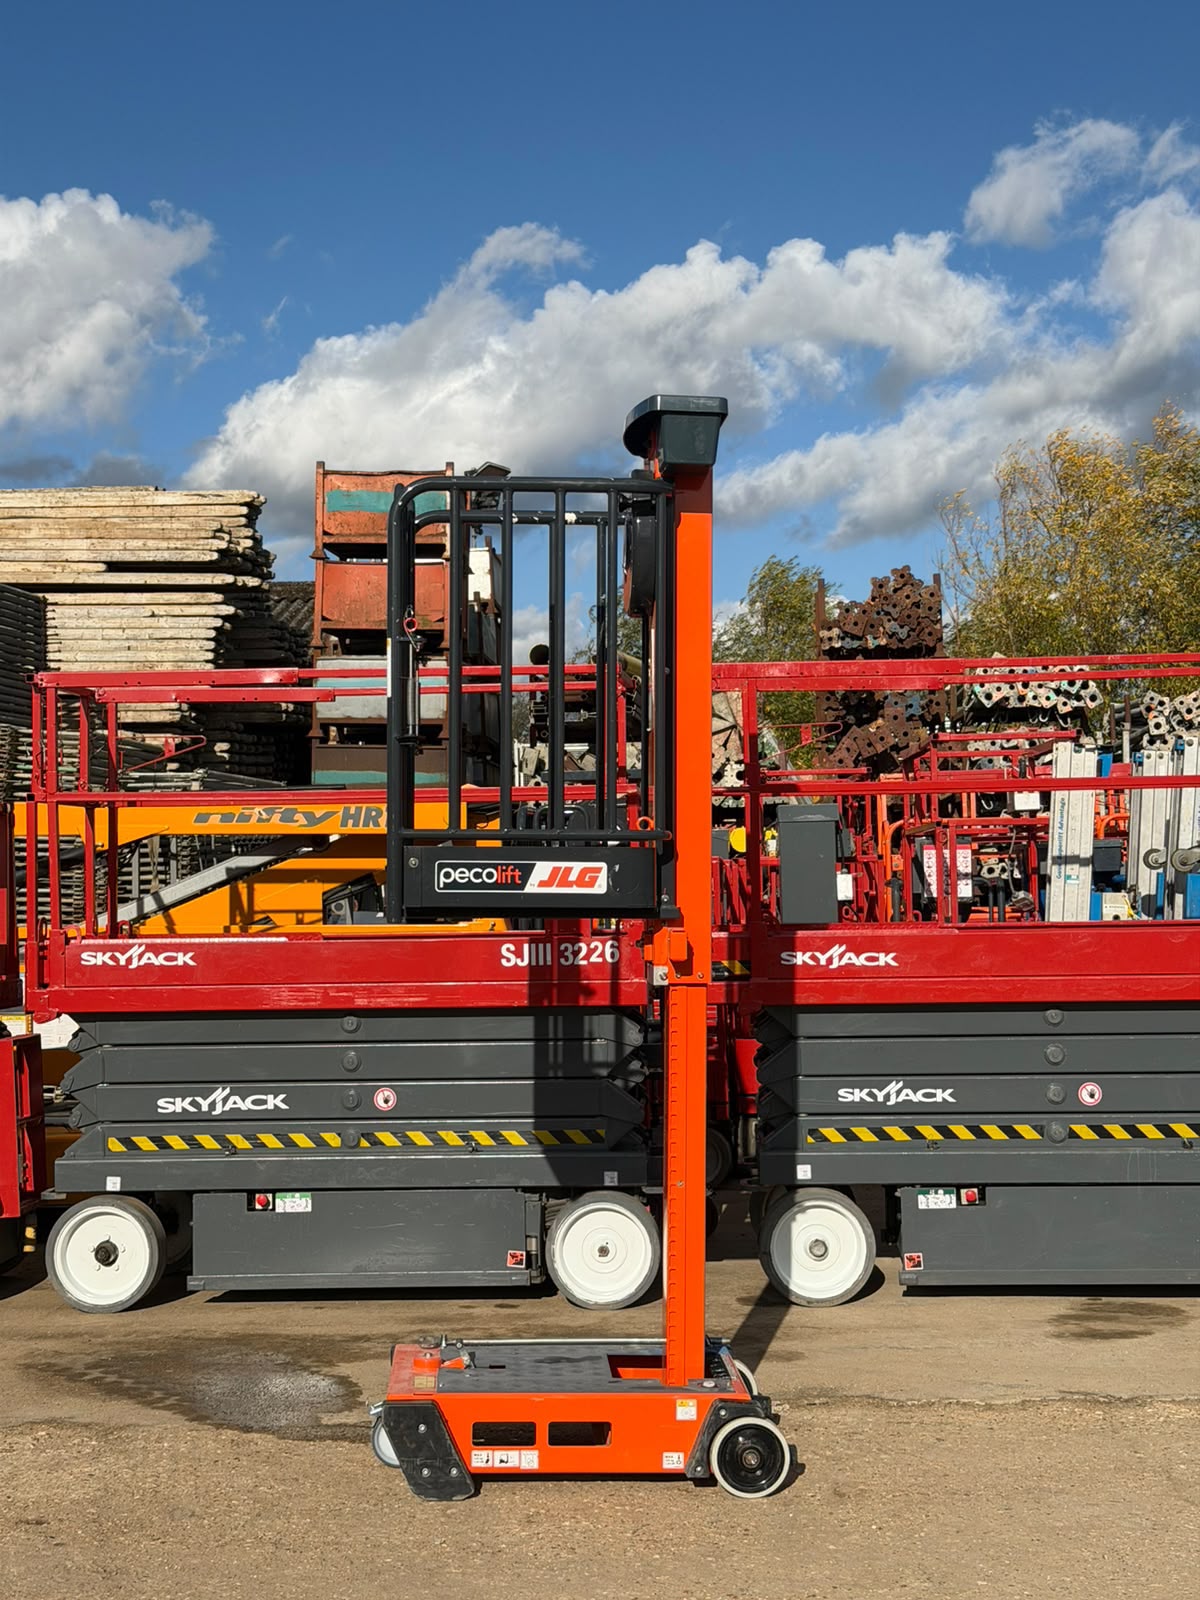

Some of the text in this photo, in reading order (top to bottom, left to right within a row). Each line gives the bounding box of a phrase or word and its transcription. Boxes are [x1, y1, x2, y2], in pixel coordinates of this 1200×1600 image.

[194, 806, 388, 828] nifty HR
[439, 864, 523, 889] pecolift
[536, 866, 604, 889] JLG
[80, 943, 198, 969] SKYJACK
[500, 940, 621, 967] SJIII 3226
[779, 943, 900, 969] SKYJACK
[156, 1086, 290, 1116] SKYJACK
[837, 1080, 957, 1106] SKYJACK
